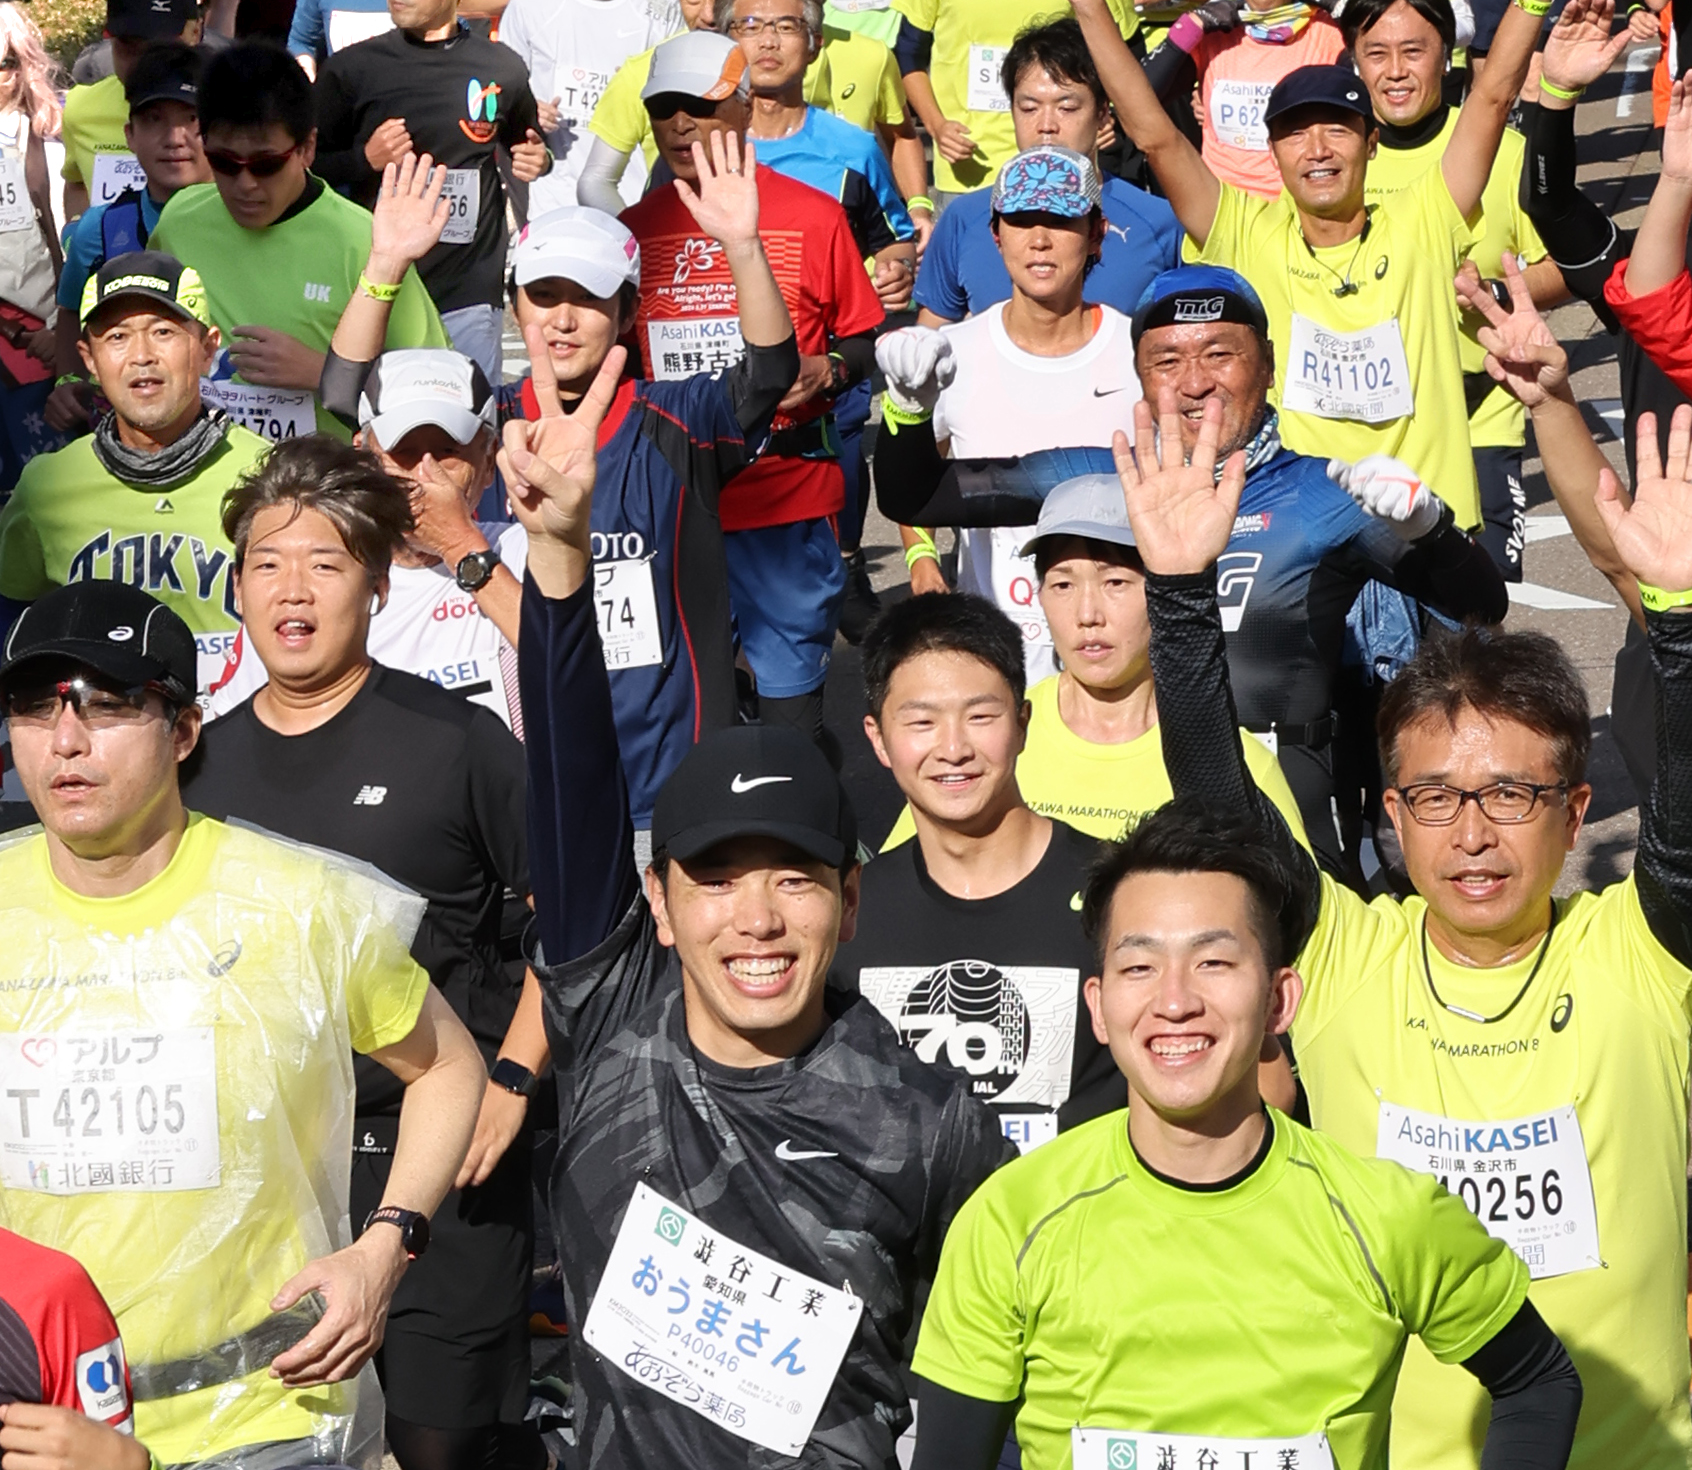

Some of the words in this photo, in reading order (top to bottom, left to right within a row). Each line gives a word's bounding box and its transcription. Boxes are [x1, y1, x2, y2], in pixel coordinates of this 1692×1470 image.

[304, 283, 331, 304] UK
[661, 321, 739, 340] AsahiKAS
[1303, 350, 1394, 391] R41102
[1067, 805, 1138, 821] MARATHON
[65, 1034, 164, 1066] アルプ
[1447, 1038, 1528, 1058] MARATHON
[72, 1068, 117, 1083] 東京都
[7, 1084, 187, 1139] T42105
[1398, 1115, 1559, 1153] AsahiKASEI
[57, 1159, 176, 1188] 北國銀行
[1428, 1155, 1467, 1173] 石川県
[1473, 1157, 1519, 1174] 金沢市
[703, 1273, 748, 1308] 愛知県
[632, 1254, 807, 1377] おうまさん
[667, 1323, 741, 1374] P40046
[625, 1340, 748, 1429] あおぞら薬局
